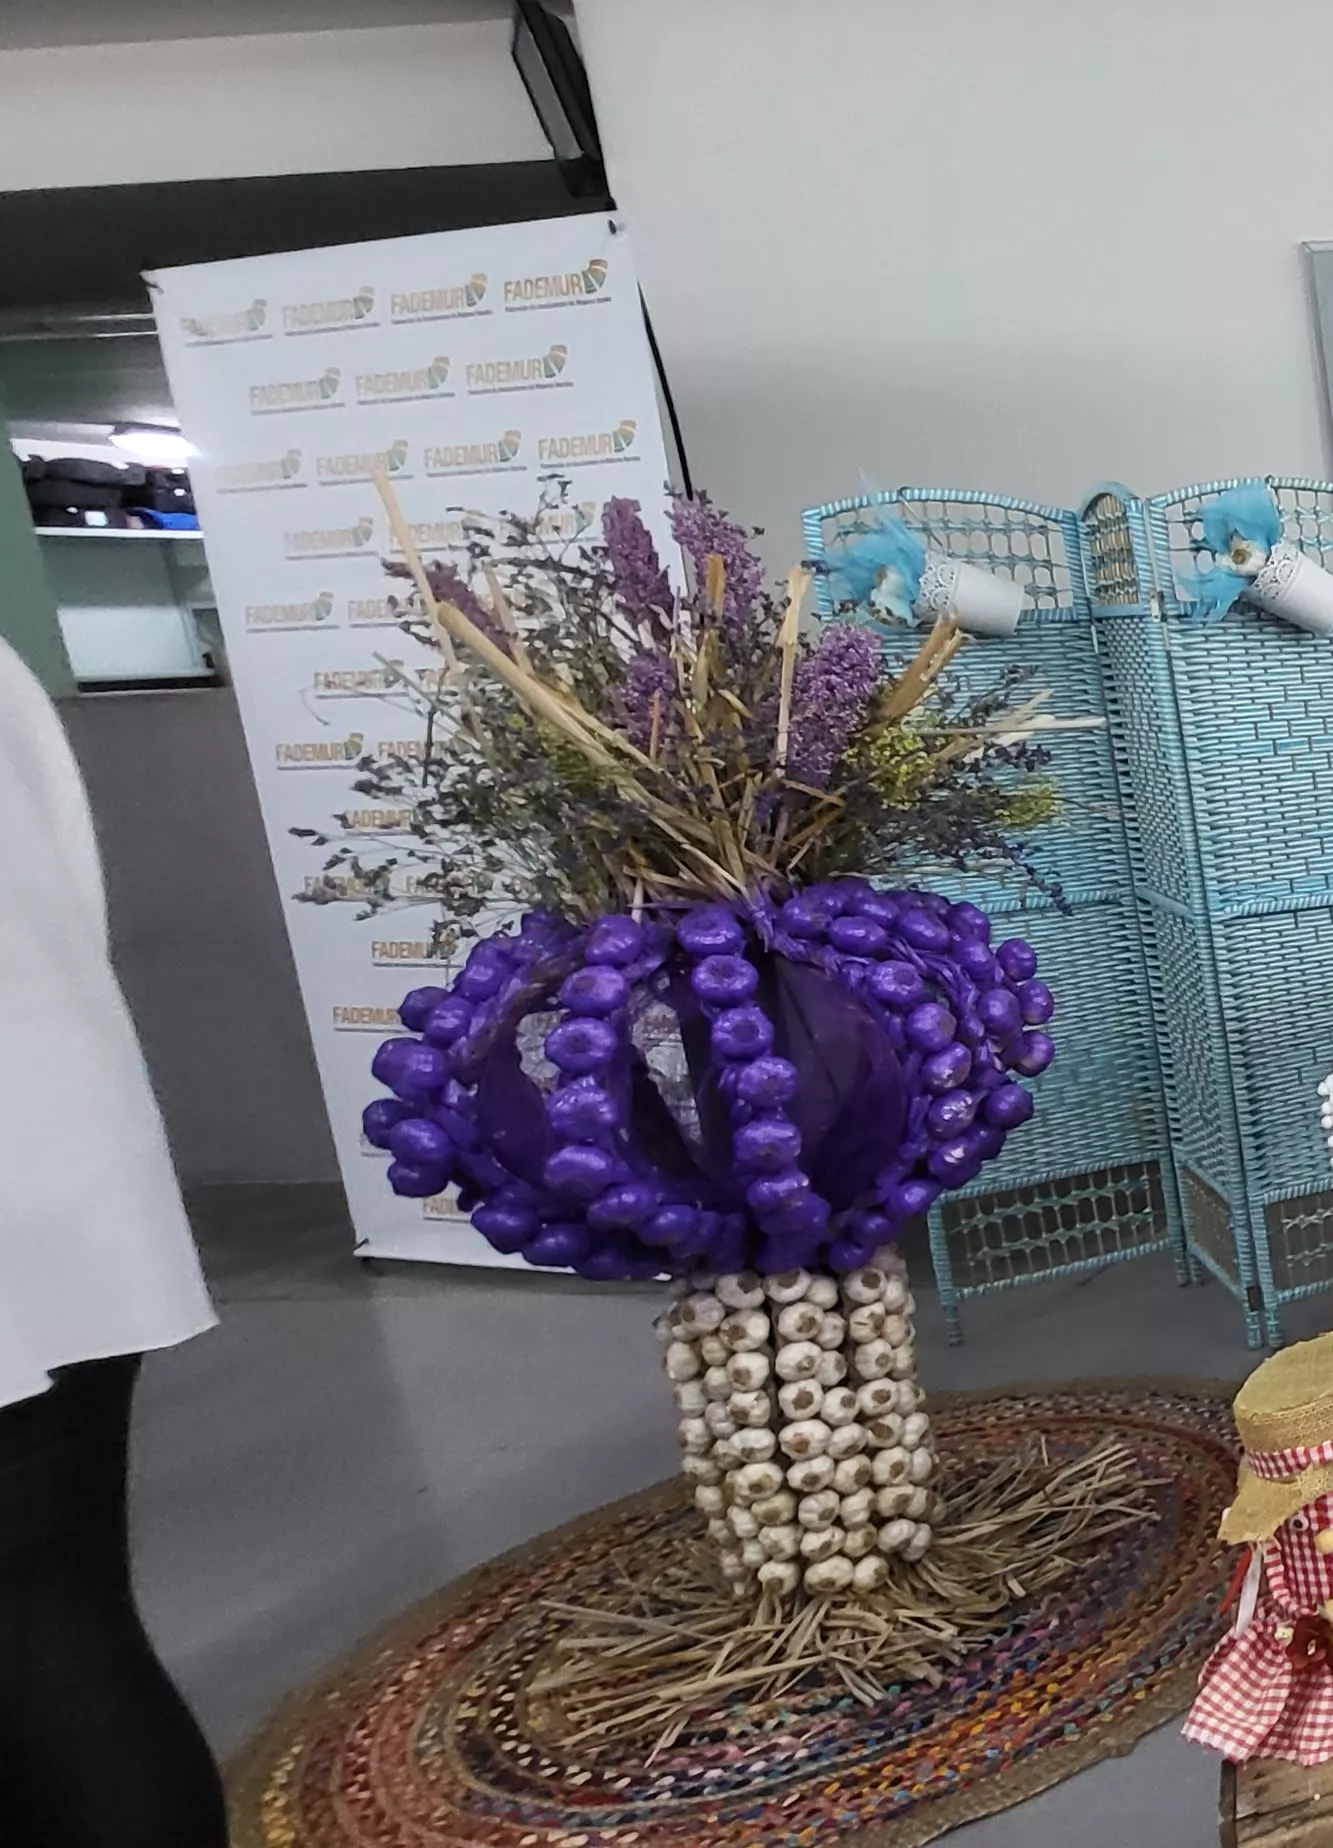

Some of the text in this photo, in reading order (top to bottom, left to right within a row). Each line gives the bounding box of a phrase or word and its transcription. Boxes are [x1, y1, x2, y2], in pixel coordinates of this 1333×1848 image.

[391, 287, 465, 315] FADEMUR
[504, 273, 584, 302] FADEMUR
[355, 369, 430, 397] FADEMUR
[465, 359, 543, 386] FADEMUR
[250, 381, 320, 407] FADEMUR
[424, 443, 500, 469] FADEMUR
[538, 433, 613, 460] FADEMUR
[245, 602, 315, 625] FADEMUR
[275, 743, 345, 762] FADEMUR
